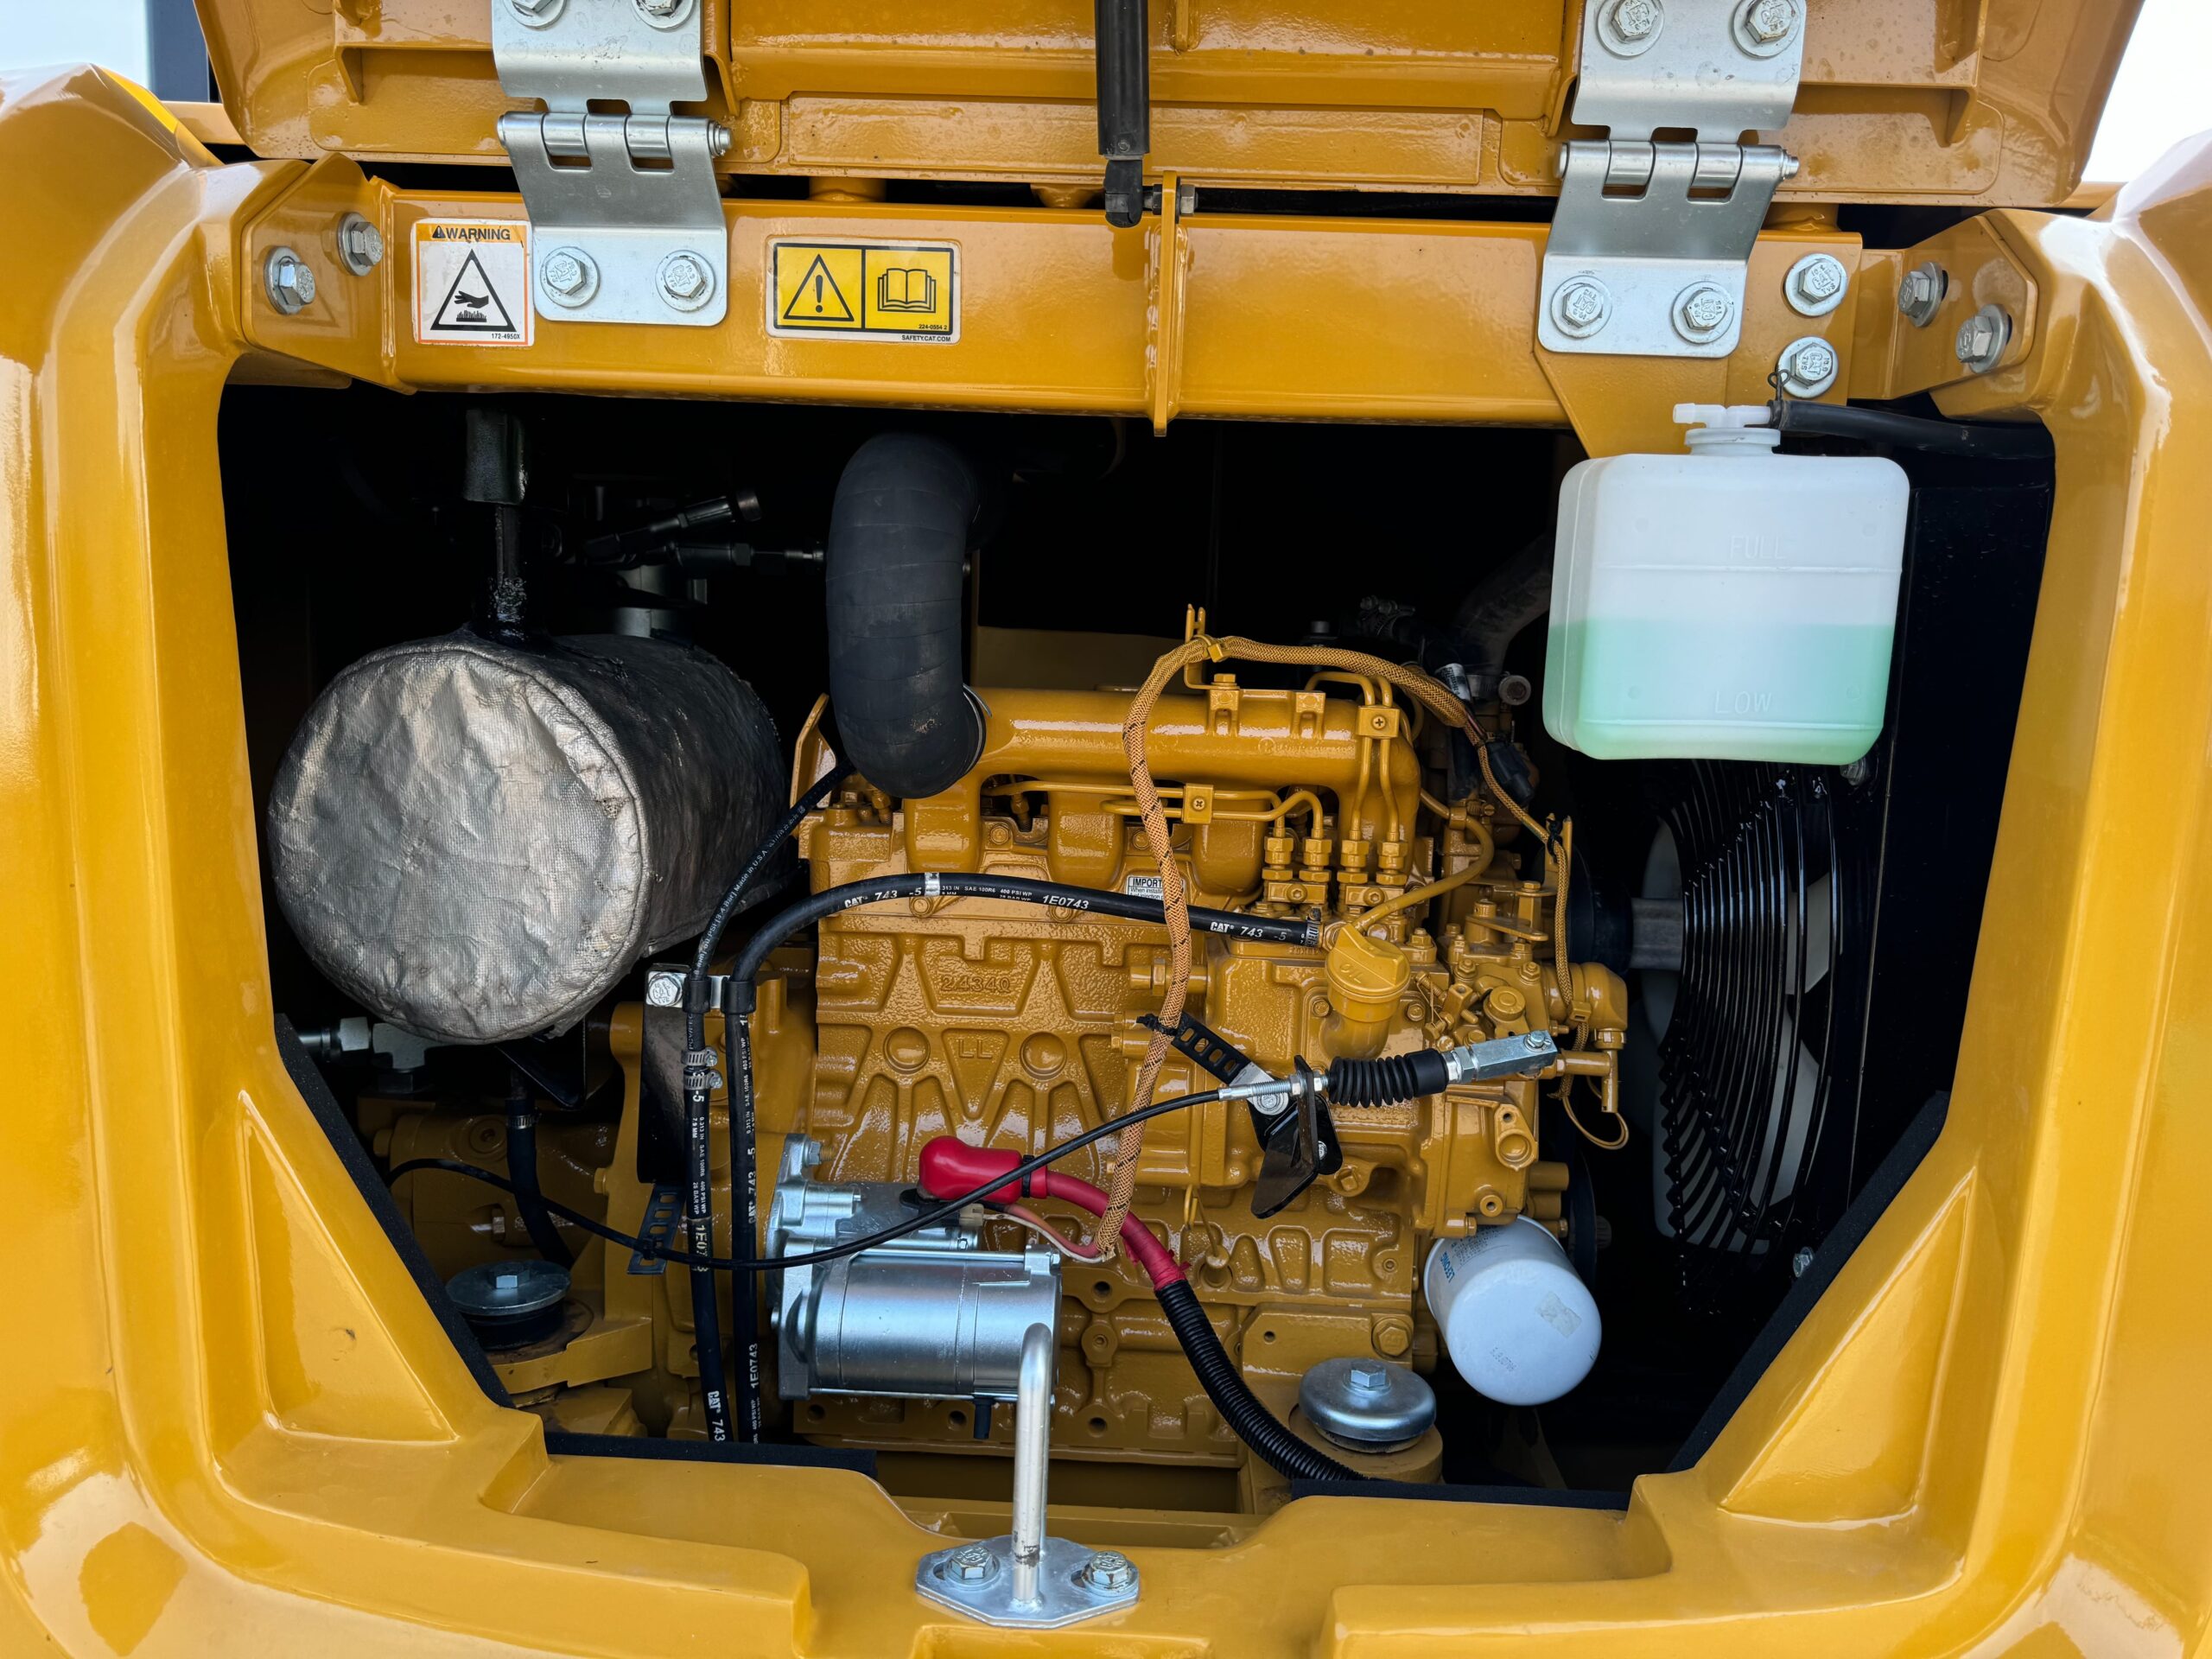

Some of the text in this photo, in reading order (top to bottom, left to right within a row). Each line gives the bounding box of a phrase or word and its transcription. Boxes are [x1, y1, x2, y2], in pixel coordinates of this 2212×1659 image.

[446, 227, 511, 240] WARNING
[1801, 356, 1809, 372] TVS
[1807, 352, 1823, 376] CAT
[1728, 535, 1789, 560] FULL
[1713, 690, 1773, 715] LOW
[734, 873, 749, 892] Made
[747, 866, 754, 875] in
[1133, 878, 1163, 887] IMPORT
[874, 889, 898, 901] 743
[908, 887, 923, 897] -5
[1042, 894, 1090, 910] 1E0743
[1239, 925, 1264, 938] 743
[1273, 931, 1288, 942] -5
[1339, 962, 1367, 984] OIL
[741, 1037, 747, 1049] WP
[957, 1037, 994, 1059] LL
[692, 1090, 705, 1103] -5
[692, 1127, 698, 1139] MM
[699, 1132, 705, 1141] IN
[747, 1171, 757, 1195] 743
[693, 1204, 700, 1215] WP
[701, 1202, 707, 1214] WP
[695, 1224, 709, 1272] 1E073
[749, 1343, 760, 1389] 1E0743
[711, 1419, 726, 1442] 743
